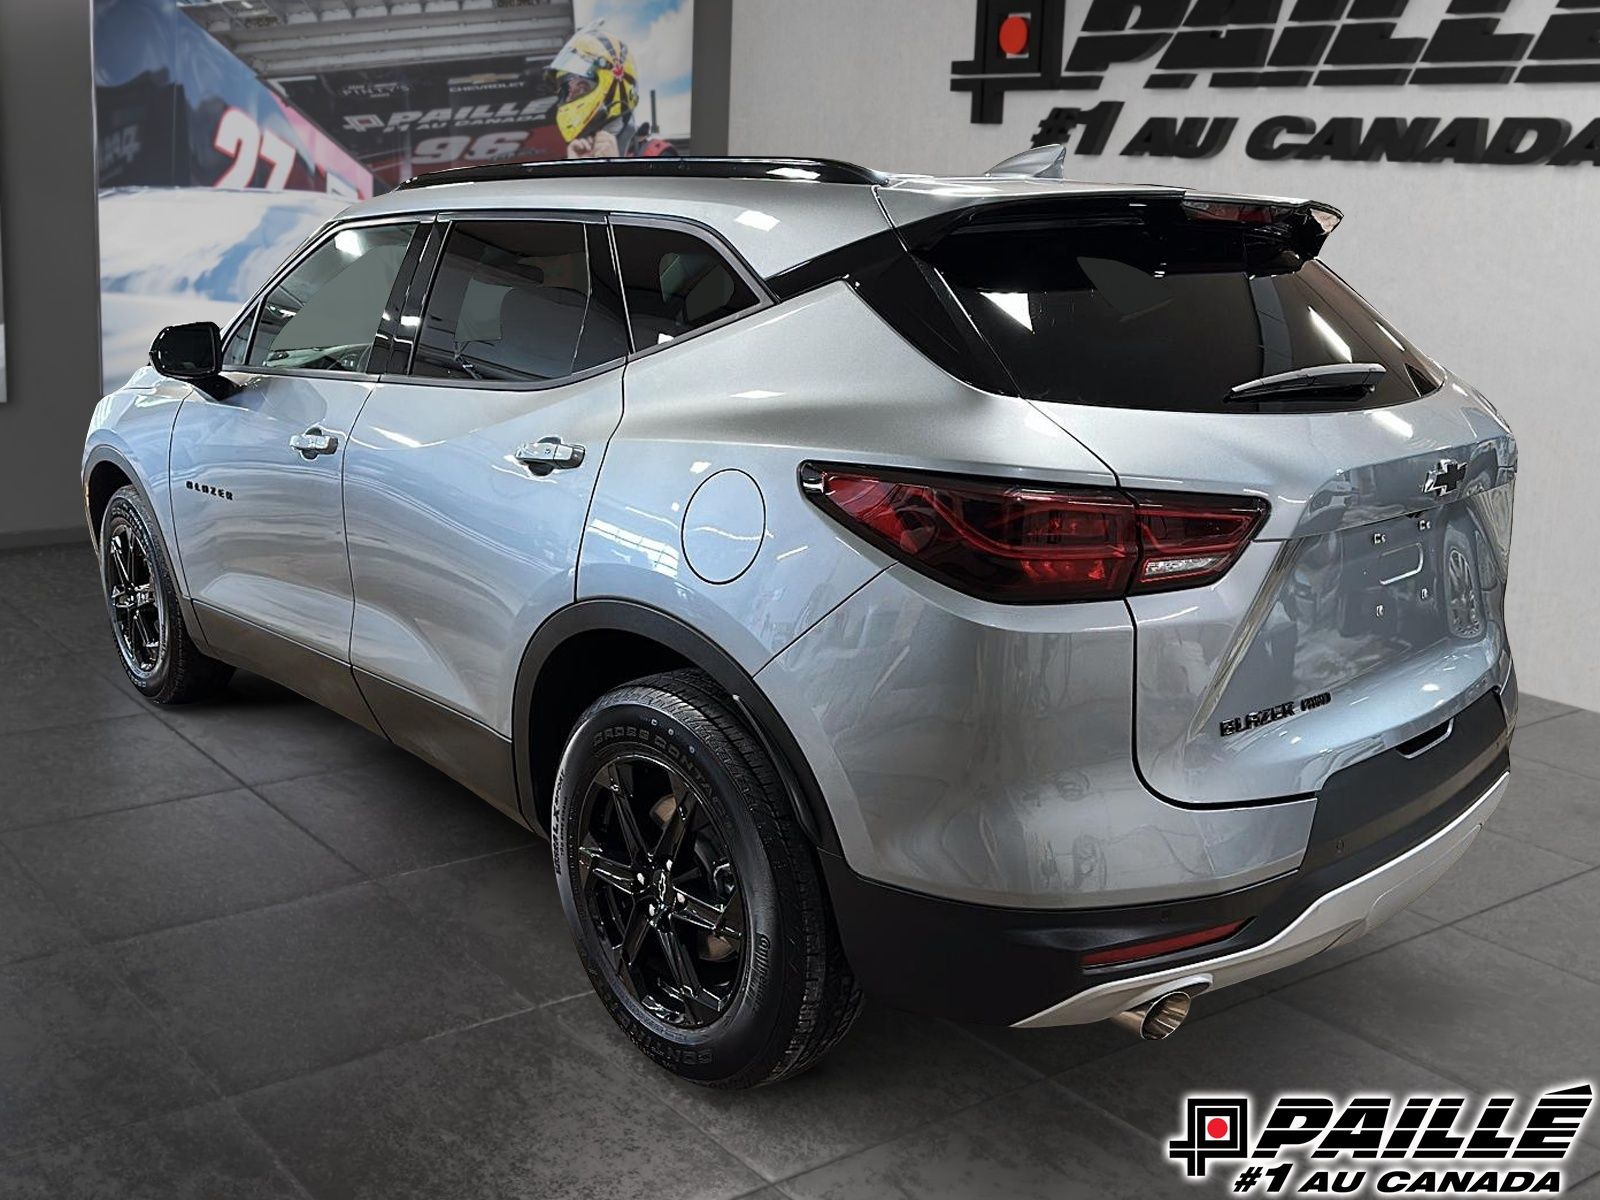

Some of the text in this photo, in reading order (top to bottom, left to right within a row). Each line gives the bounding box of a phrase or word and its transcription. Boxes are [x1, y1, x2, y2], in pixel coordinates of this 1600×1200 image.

[448, 81, 526, 93] CHEVROLET
[454, 114, 546, 127] CANADA
[1030, 101, 1600, 166] #1 AU CANADA
[213, 107, 296, 190] 27
[411, 131, 530, 164] 96
[186, 480, 233, 500] BLAZER
[1220, 701, 1295, 737] BLAZER
